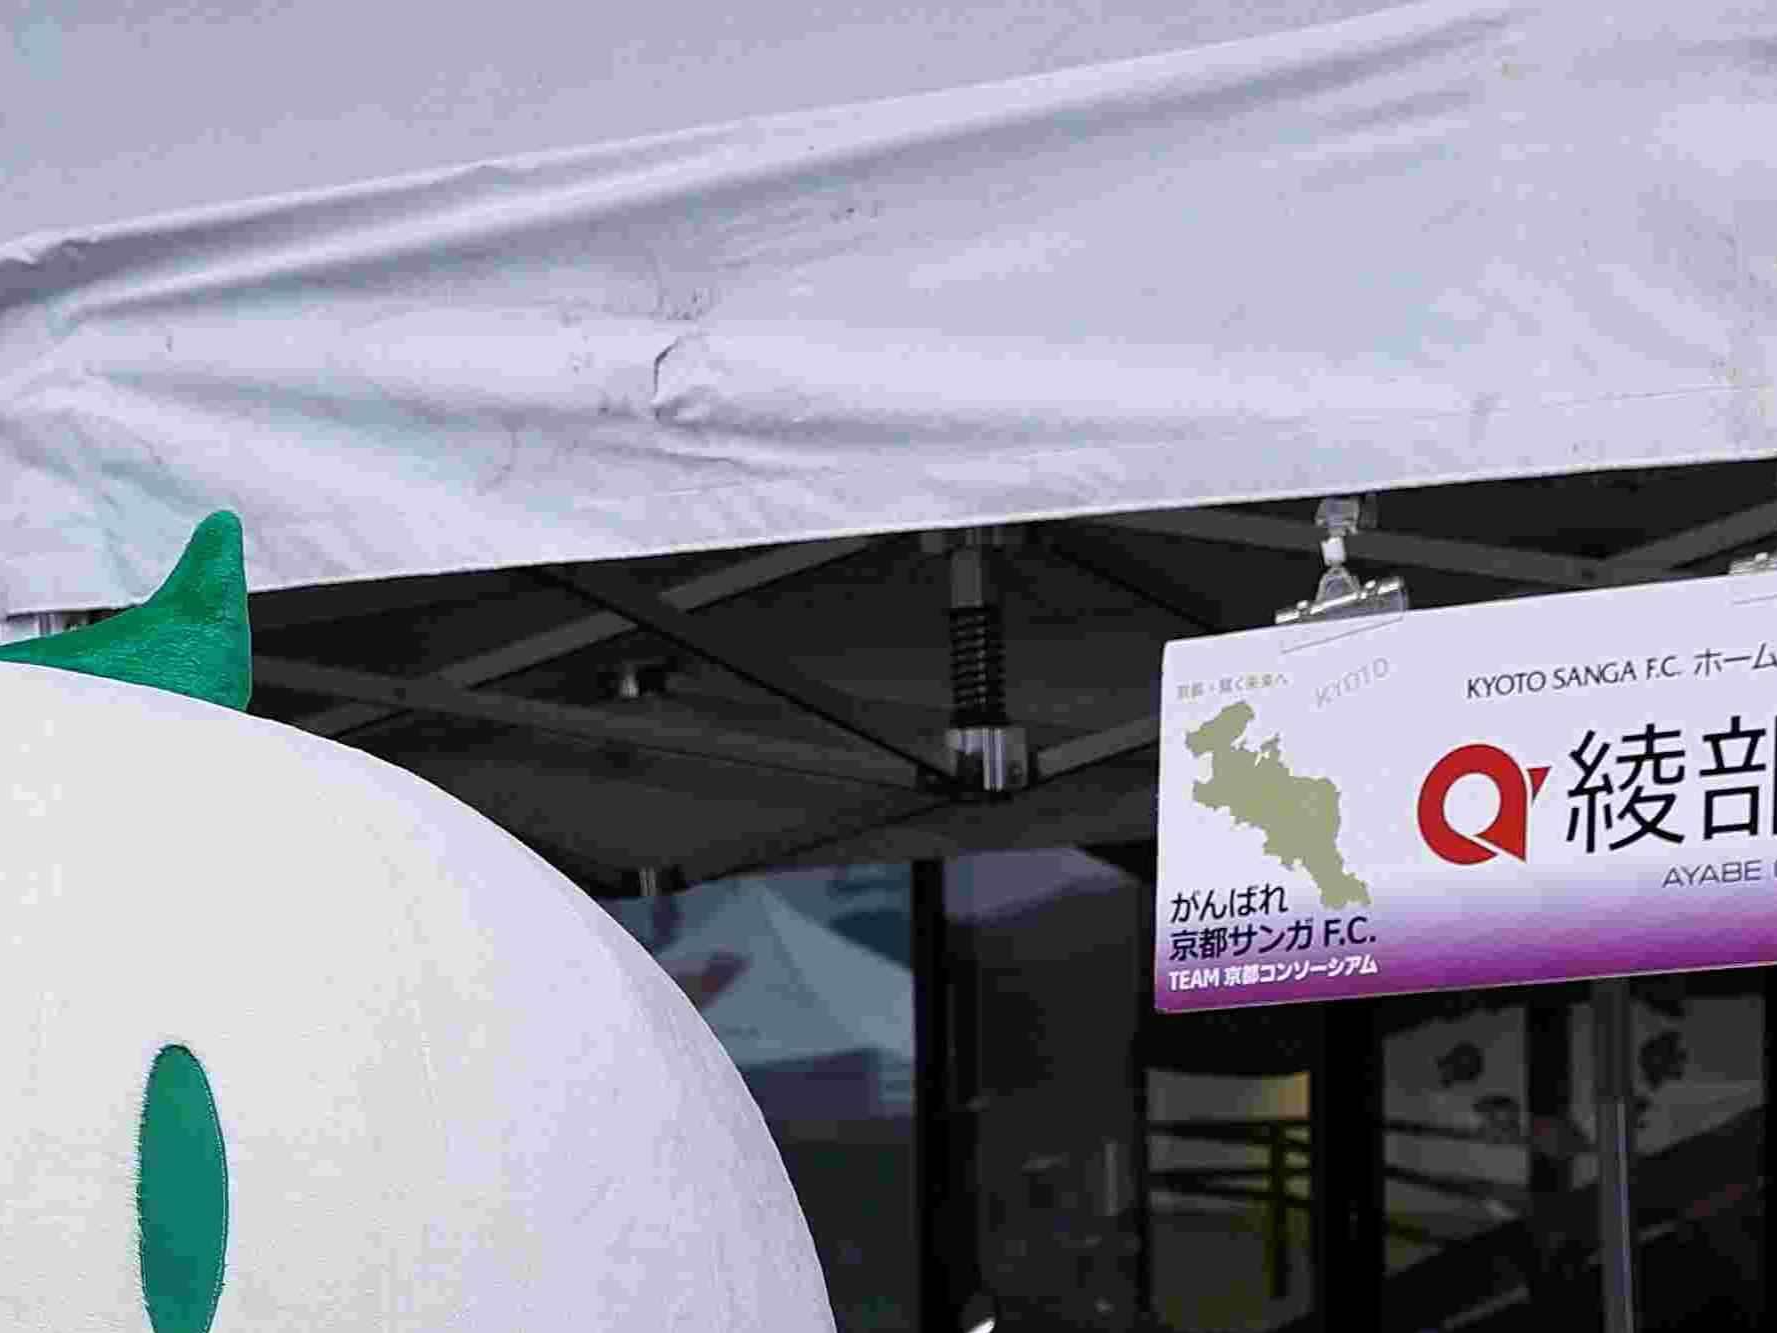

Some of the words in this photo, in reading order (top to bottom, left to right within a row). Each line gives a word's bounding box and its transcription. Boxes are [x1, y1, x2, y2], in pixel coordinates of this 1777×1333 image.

[1315, 657, 1390, 708] KYOTO
[1466, 670, 1548, 699] KYOTO
[1552, 659, 1637, 691] SANGA
[1645, 655, 1681, 681] F.C.
[1661, 858, 1762, 890] AYABE
[1170, 883, 1289, 924] がんばれ
[1168, 918, 1315, 961] 京都サンガ
[1322, 916, 1378, 948] F.C.
[1168, 969, 1220, 992] TEAM
[1223, 954, 1380, 987] 京都コンソーシアム
